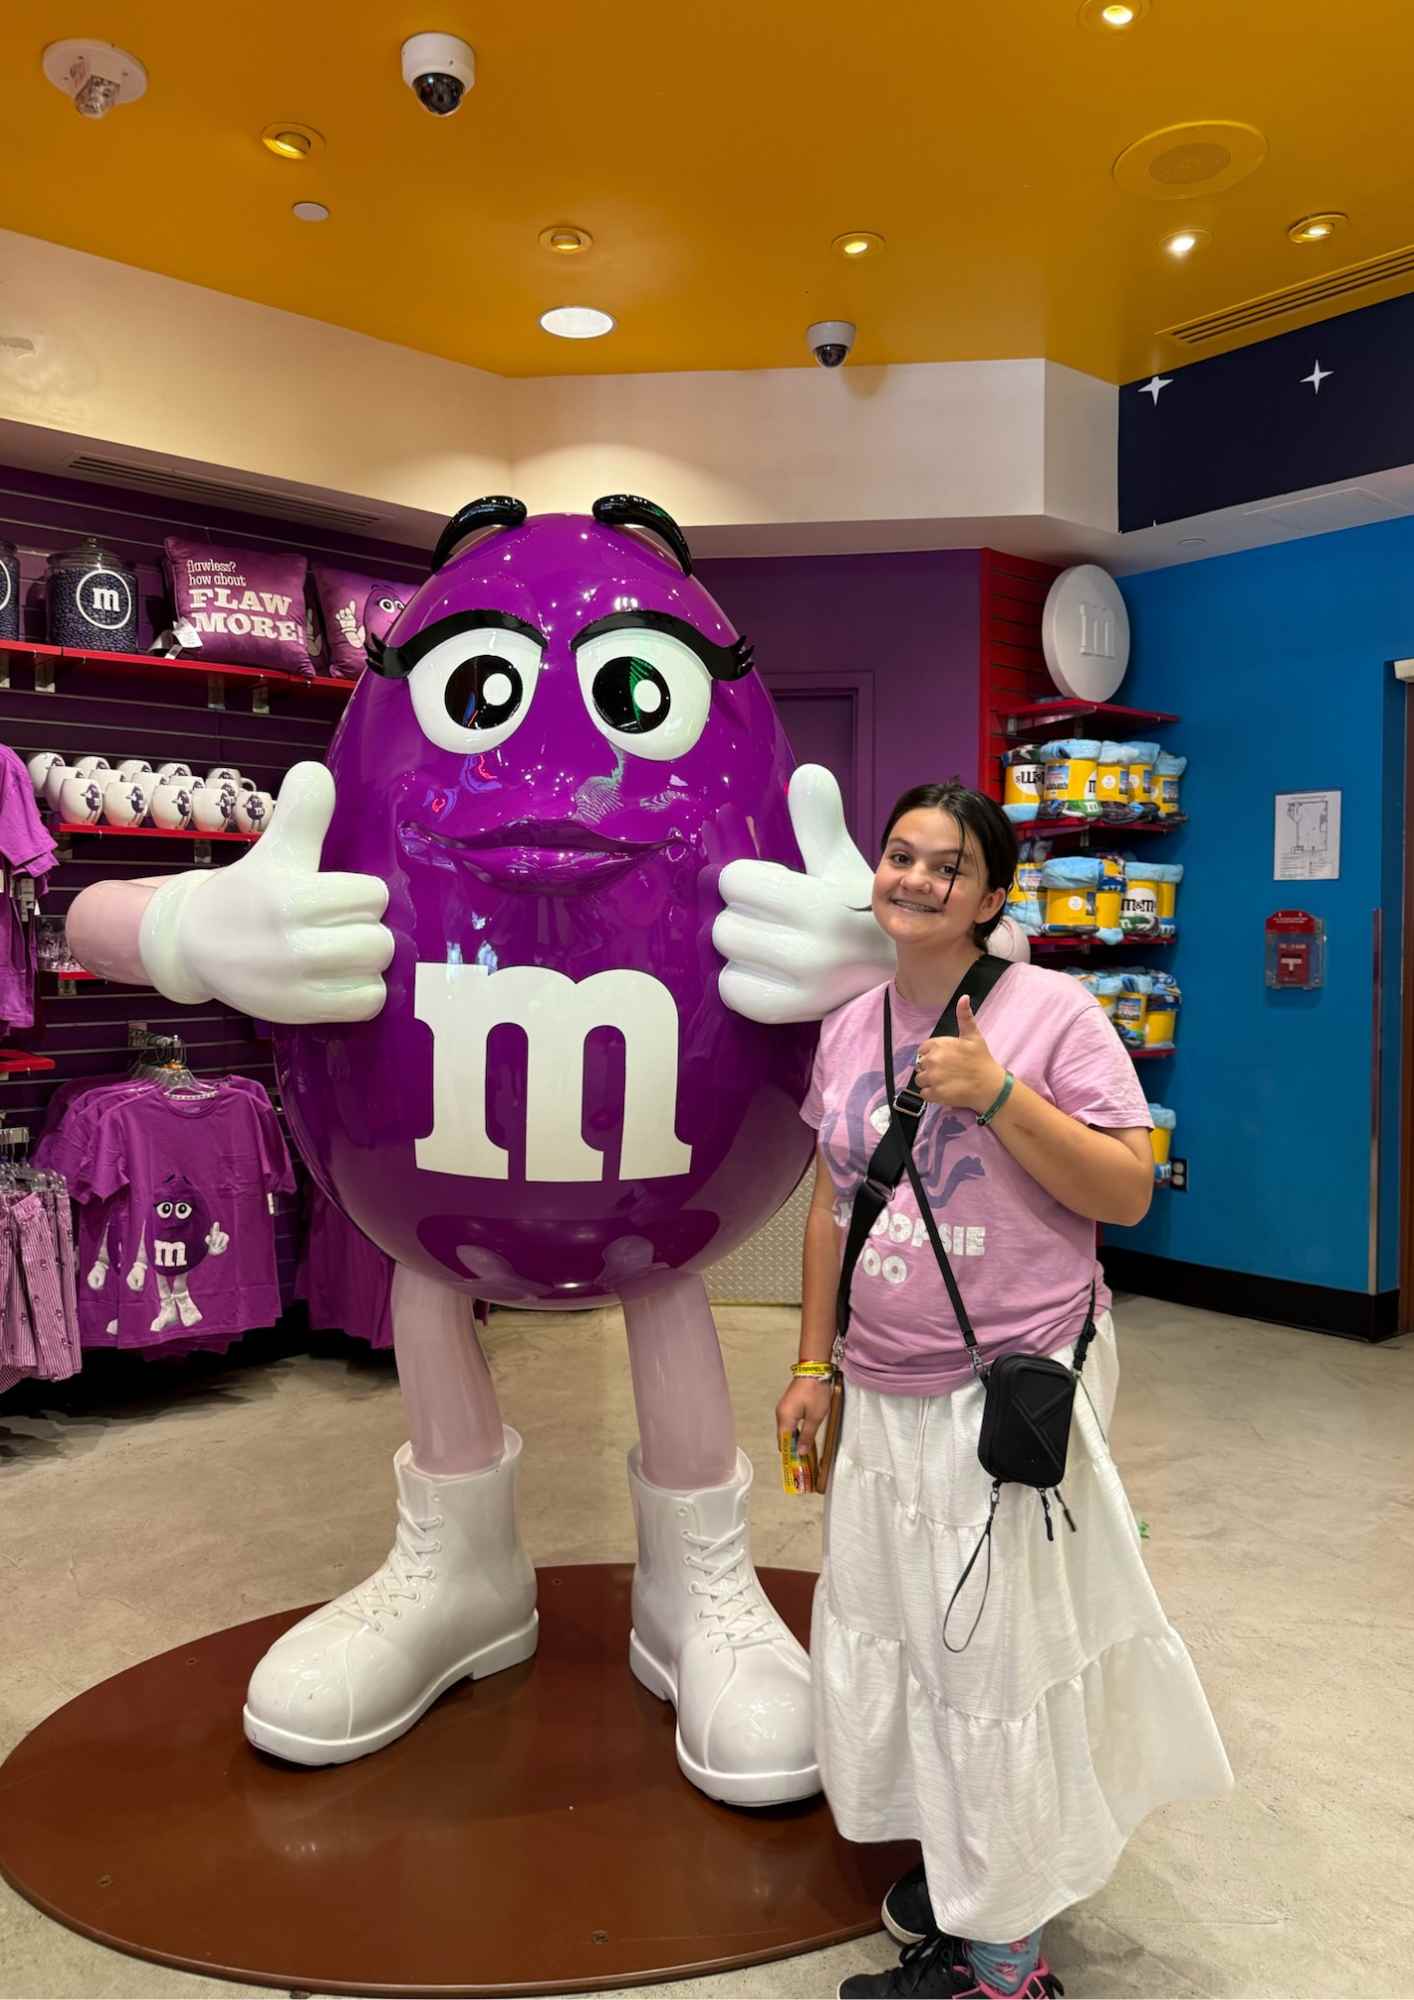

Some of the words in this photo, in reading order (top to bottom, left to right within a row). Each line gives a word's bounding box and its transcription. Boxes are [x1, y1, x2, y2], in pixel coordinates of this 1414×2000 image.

[186, 558, 237, 574] flawless?
[188, 574, 212, 587] how
[213, 572, 247, 587] about
[92, 587, 121, 612] m
[188, 587, 293, 616] FLAW
[191, 611, 305, 646] MORE!
[414, 961, 693, 1182] m
[154, 1239, 188, 1268] m
